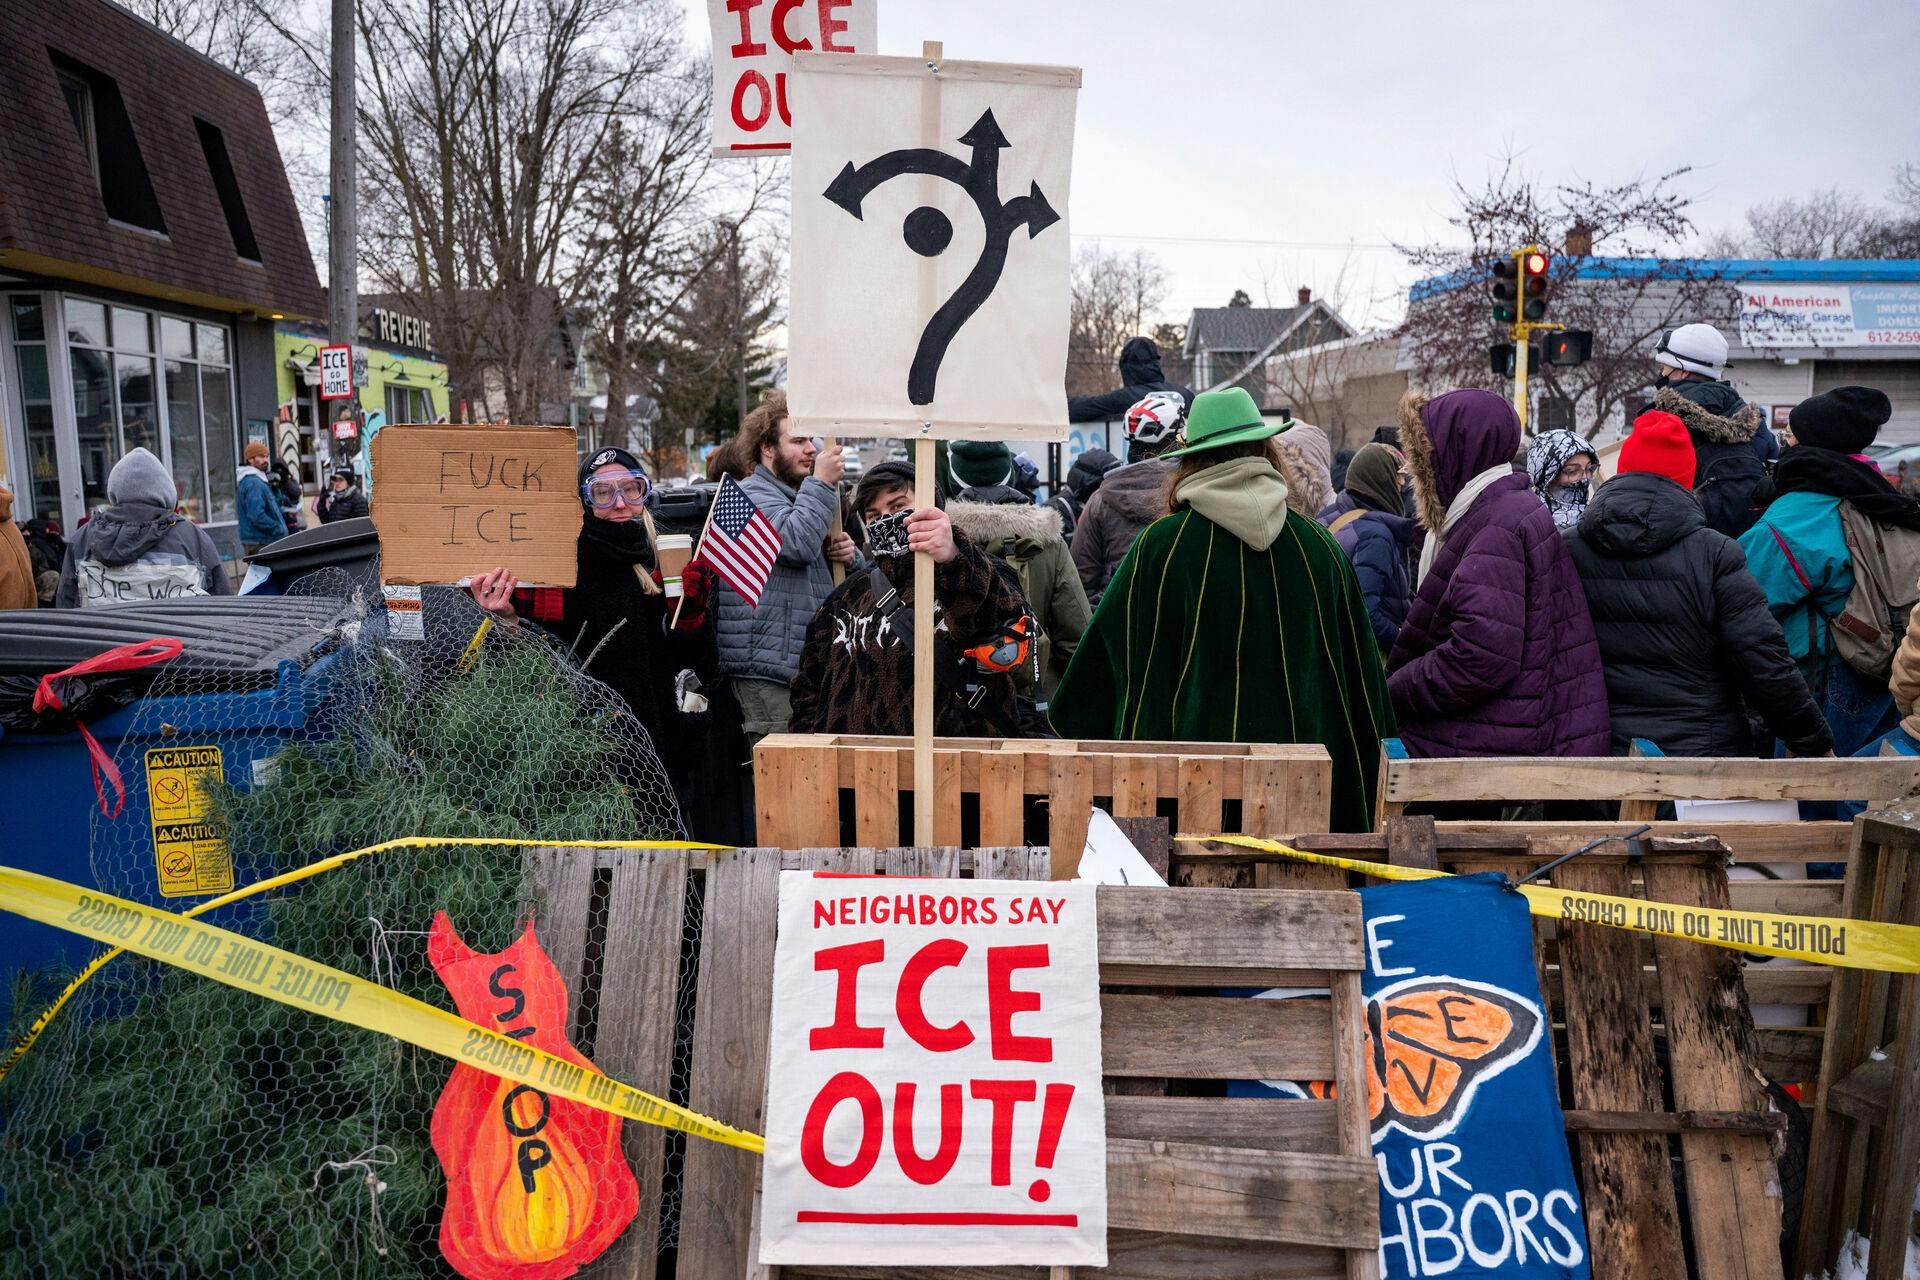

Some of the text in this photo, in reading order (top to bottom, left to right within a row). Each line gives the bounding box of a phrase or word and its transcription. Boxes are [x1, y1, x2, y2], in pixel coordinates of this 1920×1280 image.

[726, 0, 855, 58] ICE
[1749, 295, 1840, 308] All American
[1812, 312, 1851, 325] Garage
[379, 308, 432, 351] REVERIE
[323, 352, 347, 369] ICE
[324, 380, 348, 393] HOME
[440, 451, 547, 494] FUCK
[441, 505, 533, 545] ICE
[84, 565, 137, 600] She
[163, 750, 219, 767] CAUTION
[171, 825, 224, 841] CAUTIO
[813, 894, 1066, 929] NEIGHBORS SAY
[1561, 895, 1846, 956] POLICE LINE DO NOT CROSS
[809, 938, 1053, 1063] ICE
[489, 963, 551, 1194] SOP
[800, 1070, 1076, 1203] OUT!
